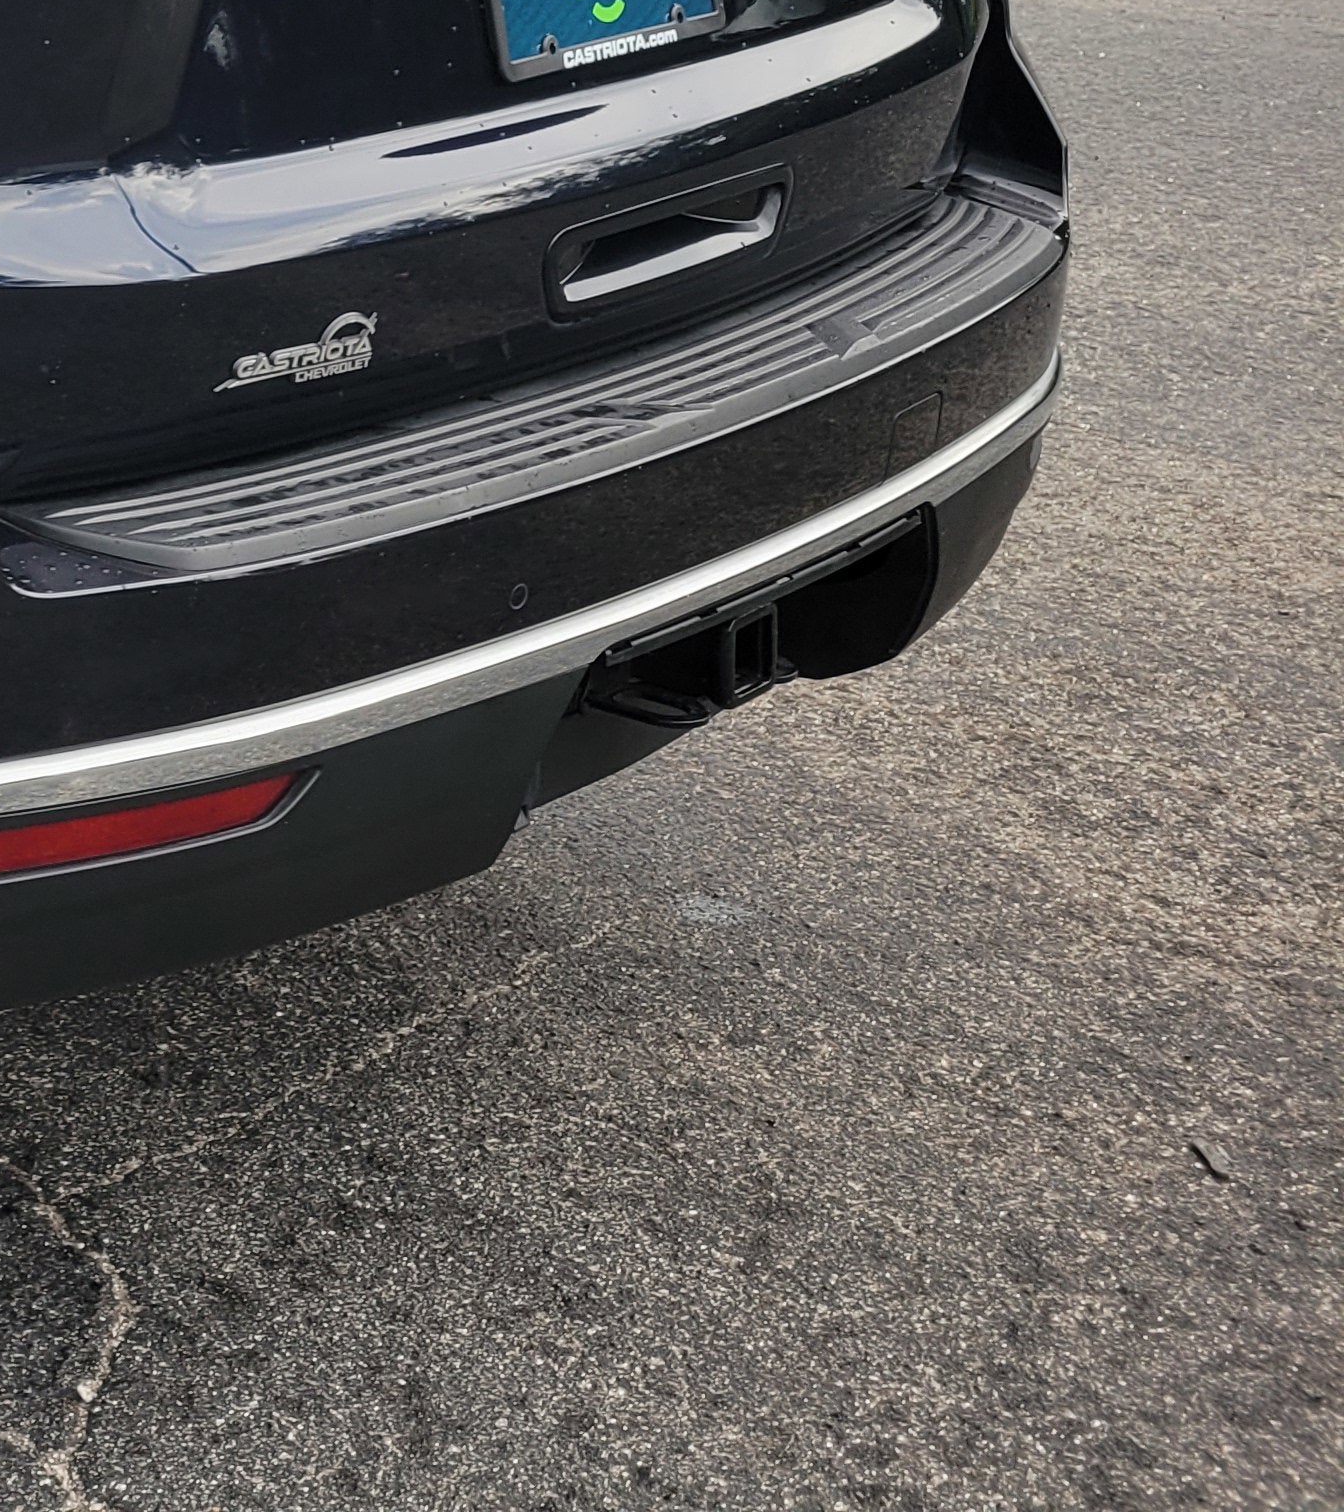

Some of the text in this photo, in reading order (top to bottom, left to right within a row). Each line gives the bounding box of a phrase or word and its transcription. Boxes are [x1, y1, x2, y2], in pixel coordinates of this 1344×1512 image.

[563, 29, 678, 69] CASTRIOTA.com
[233, 334, 372, 379] CASTRIOTA
[294, 356, 372, 383] CHEVROLET
